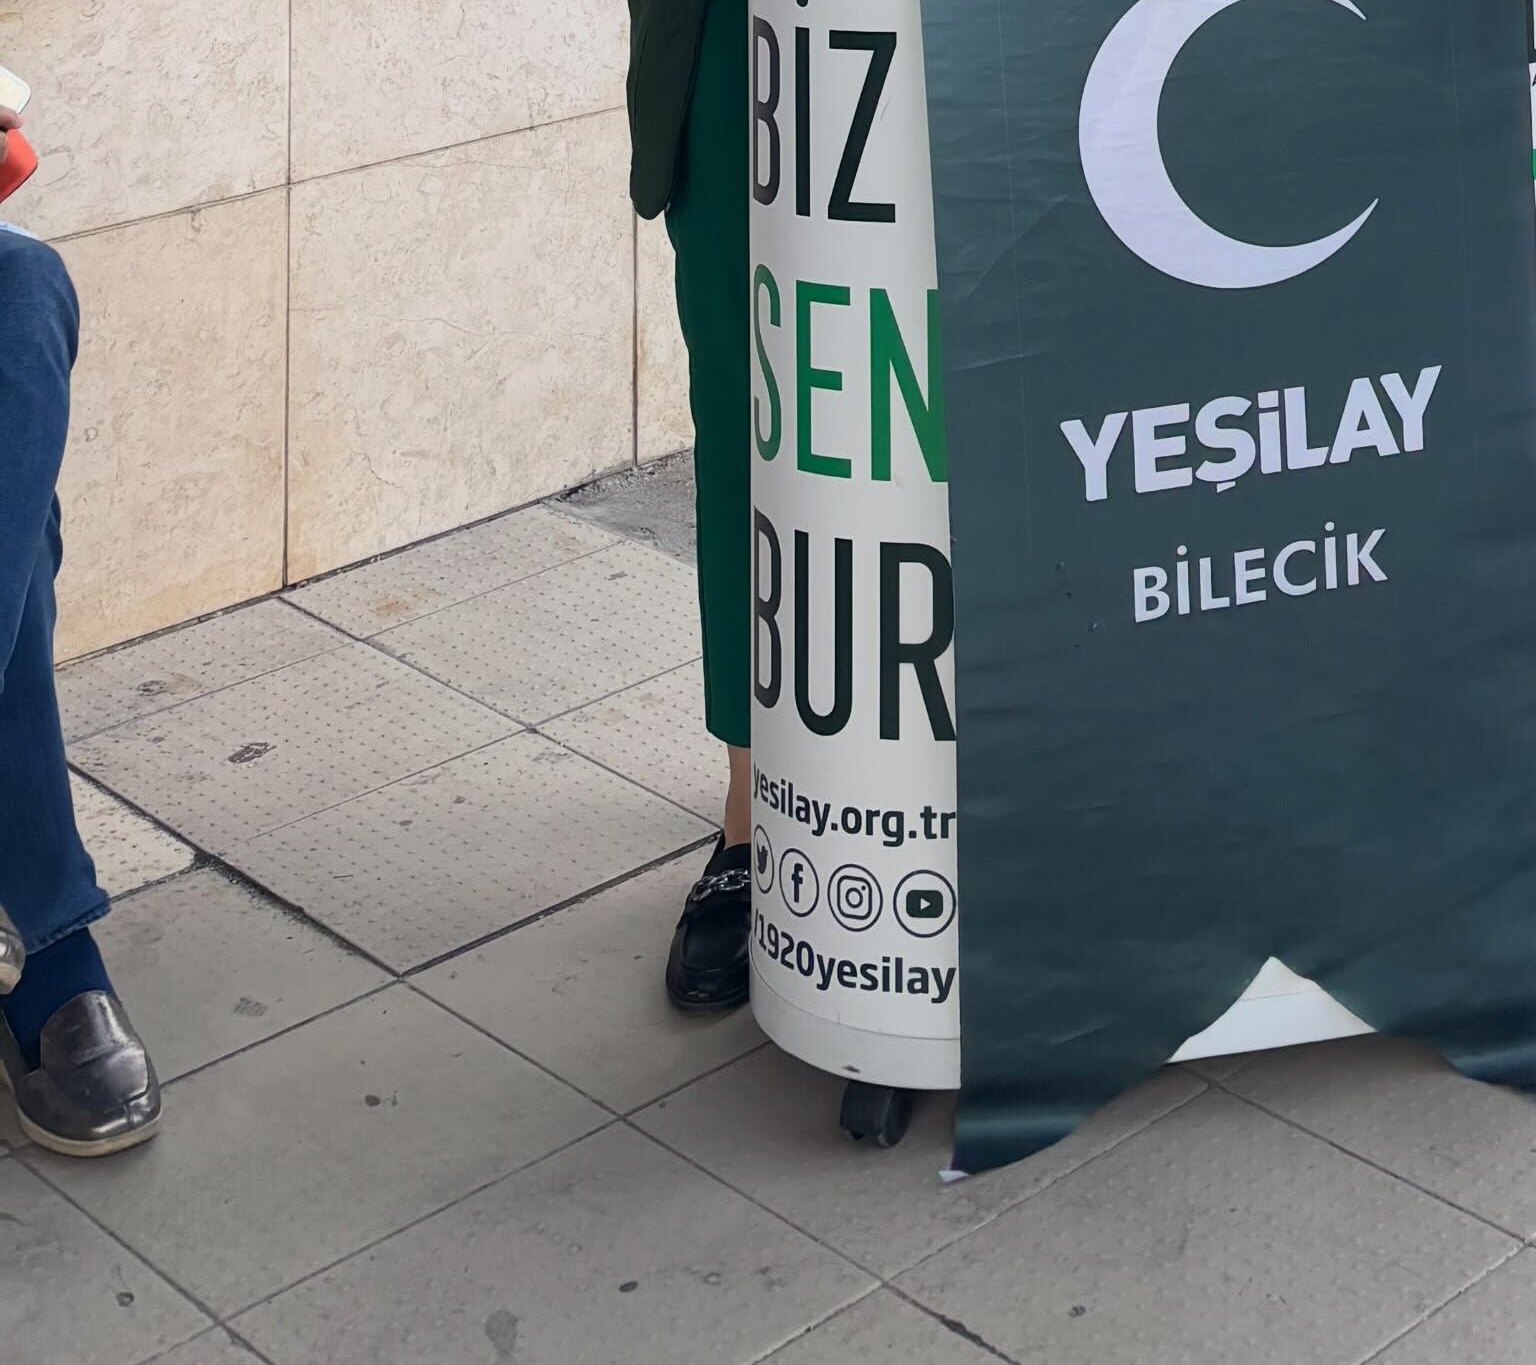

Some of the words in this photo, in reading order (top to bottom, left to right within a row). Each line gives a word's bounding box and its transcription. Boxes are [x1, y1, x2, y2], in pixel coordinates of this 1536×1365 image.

[754, 264, 948, 482] SEN
[1061, 365, 1442, 502] YEŞİLAY
[753, 505, 956, 742] BUR
[1133, 521, 1388, 623] BİLECİK
[753, 762, 956, 847] yesilay.org.tr
